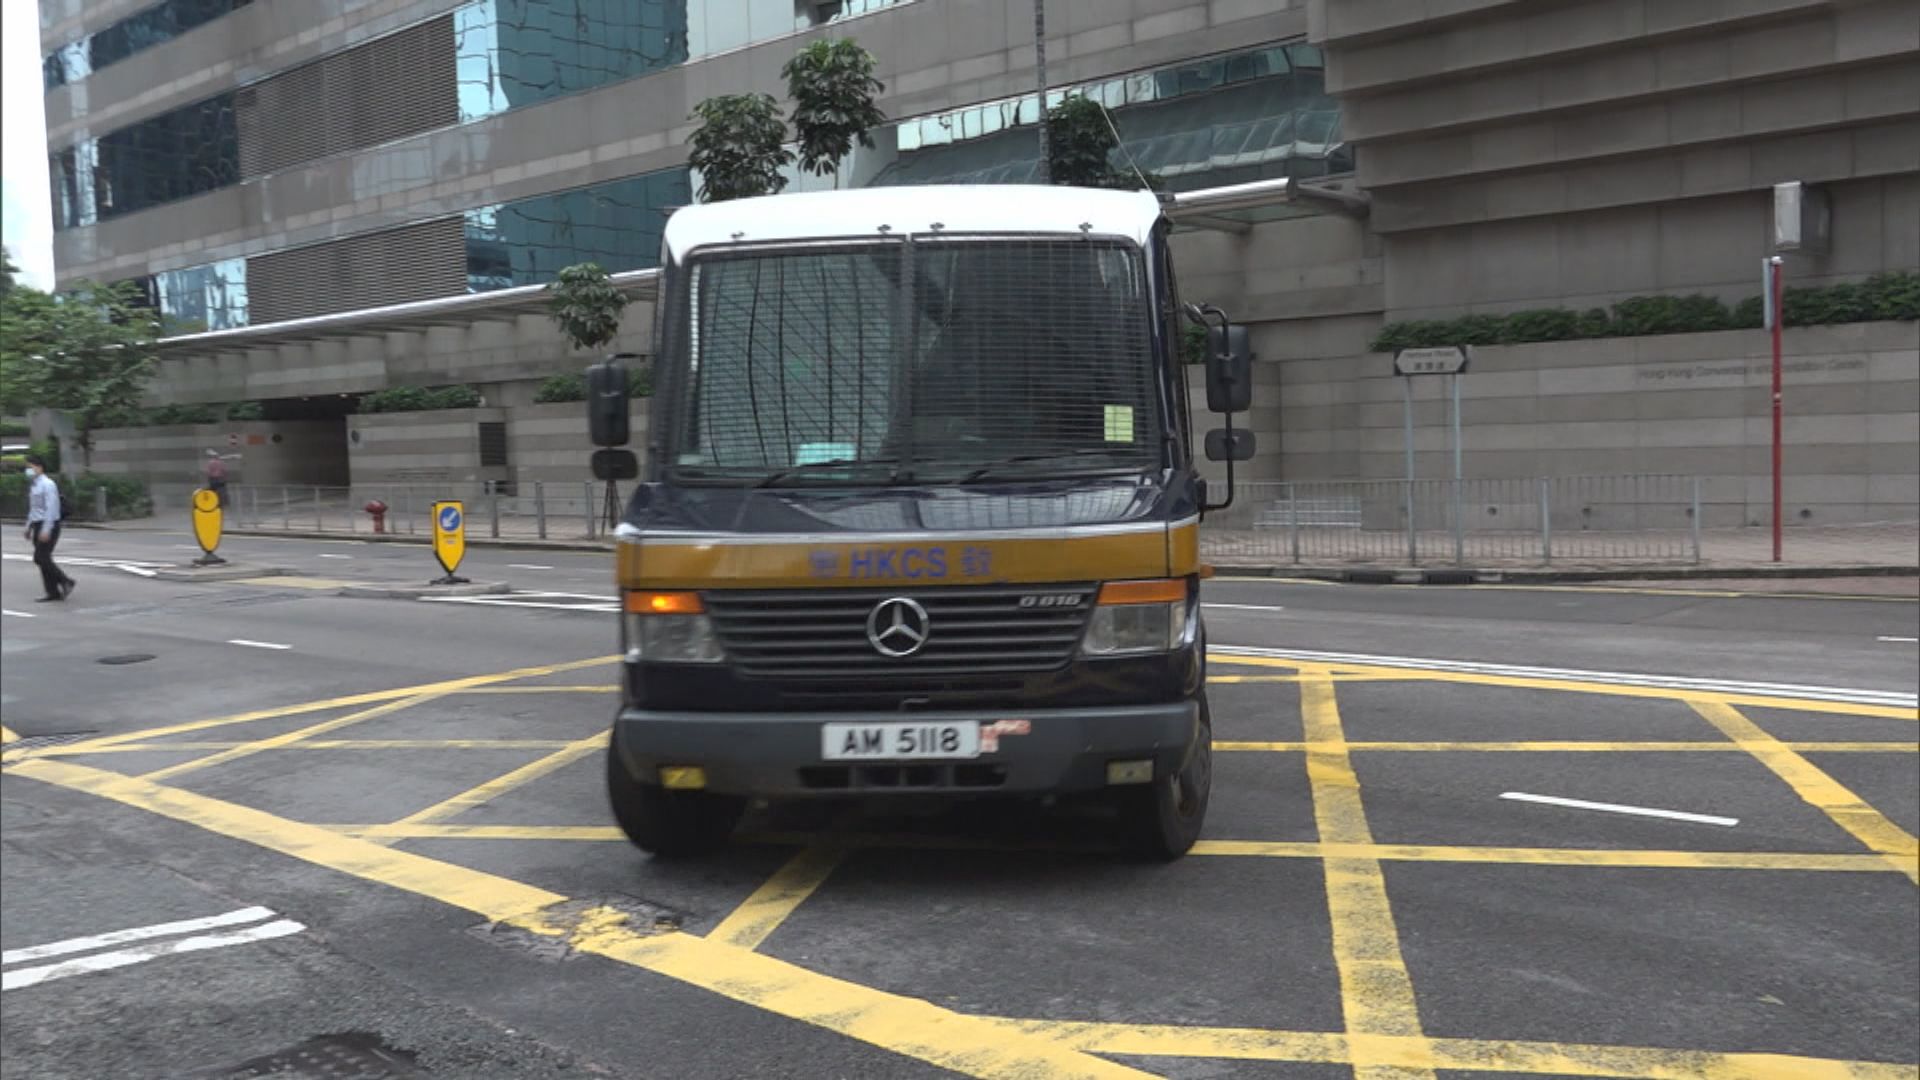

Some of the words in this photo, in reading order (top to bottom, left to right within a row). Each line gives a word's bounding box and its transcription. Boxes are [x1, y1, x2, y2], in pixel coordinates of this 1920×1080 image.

[851, 547, 946, 577] HKCS
[842, 728, 883, 754] AM
[896, 727, 960, 753] 5118
